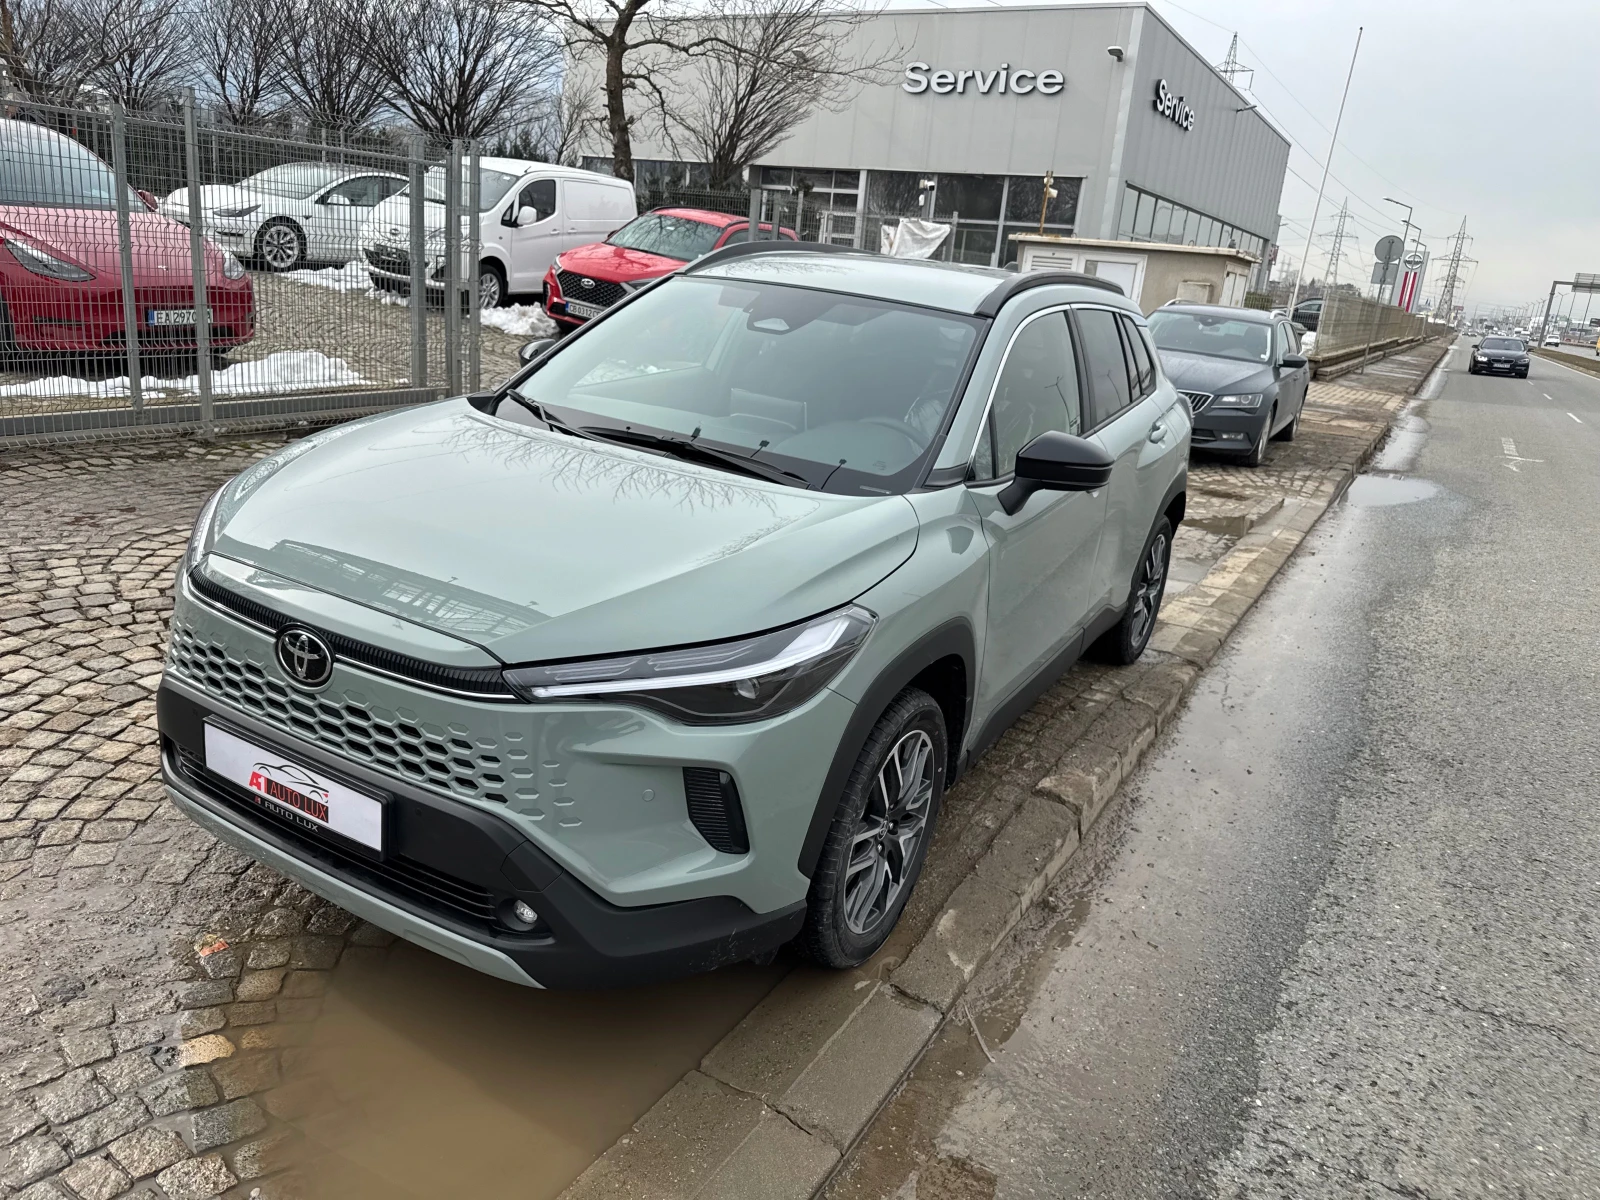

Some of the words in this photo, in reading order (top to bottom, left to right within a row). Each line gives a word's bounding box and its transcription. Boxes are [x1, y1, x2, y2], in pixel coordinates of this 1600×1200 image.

[901, 61, 1065, 95] Service
[1156, 79, 1195, 131] Service
[264, 801, 293, 820] AUTO
[296, 816, 319, 832] LUX
[270, 781, 300, 808] AUTO
[304, 796, 327, 822] LUX
